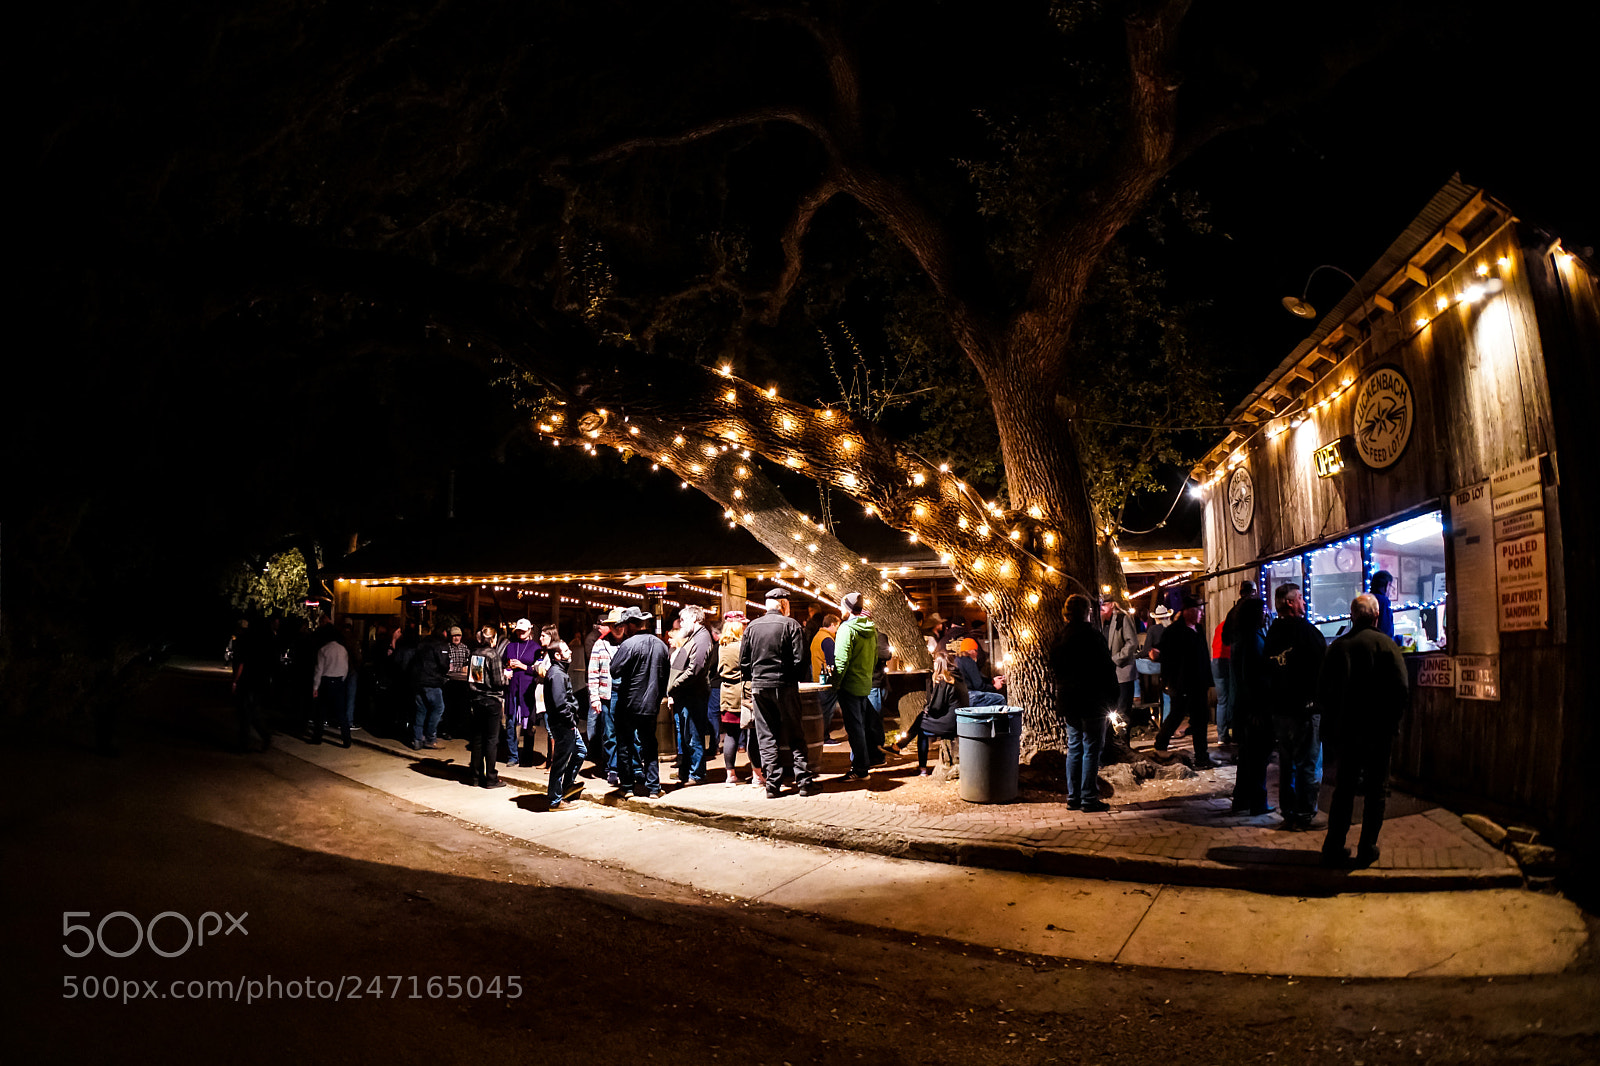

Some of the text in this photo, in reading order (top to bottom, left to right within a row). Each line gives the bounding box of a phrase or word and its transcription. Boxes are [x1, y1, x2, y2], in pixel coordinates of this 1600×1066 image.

[1355, 373, 1408, 429] LUCKENBACH
[1369, 433, 1401, 462] FEED LOT
[1315, 445, 1345, 476] OPEN
[1456, 486, 1484, 506] FEED LOT
[1502, 539, 1538, 558] PULLED
[1507, 555, 1533, 571] PORK
[1502, 588, 1542, 606] BRATWURST
[1504, 604, 1540, 619] SANDWICH
[1418, 658, 1452, 672] FUNNEL
[1419, 673, 1451, 685] CAKES
